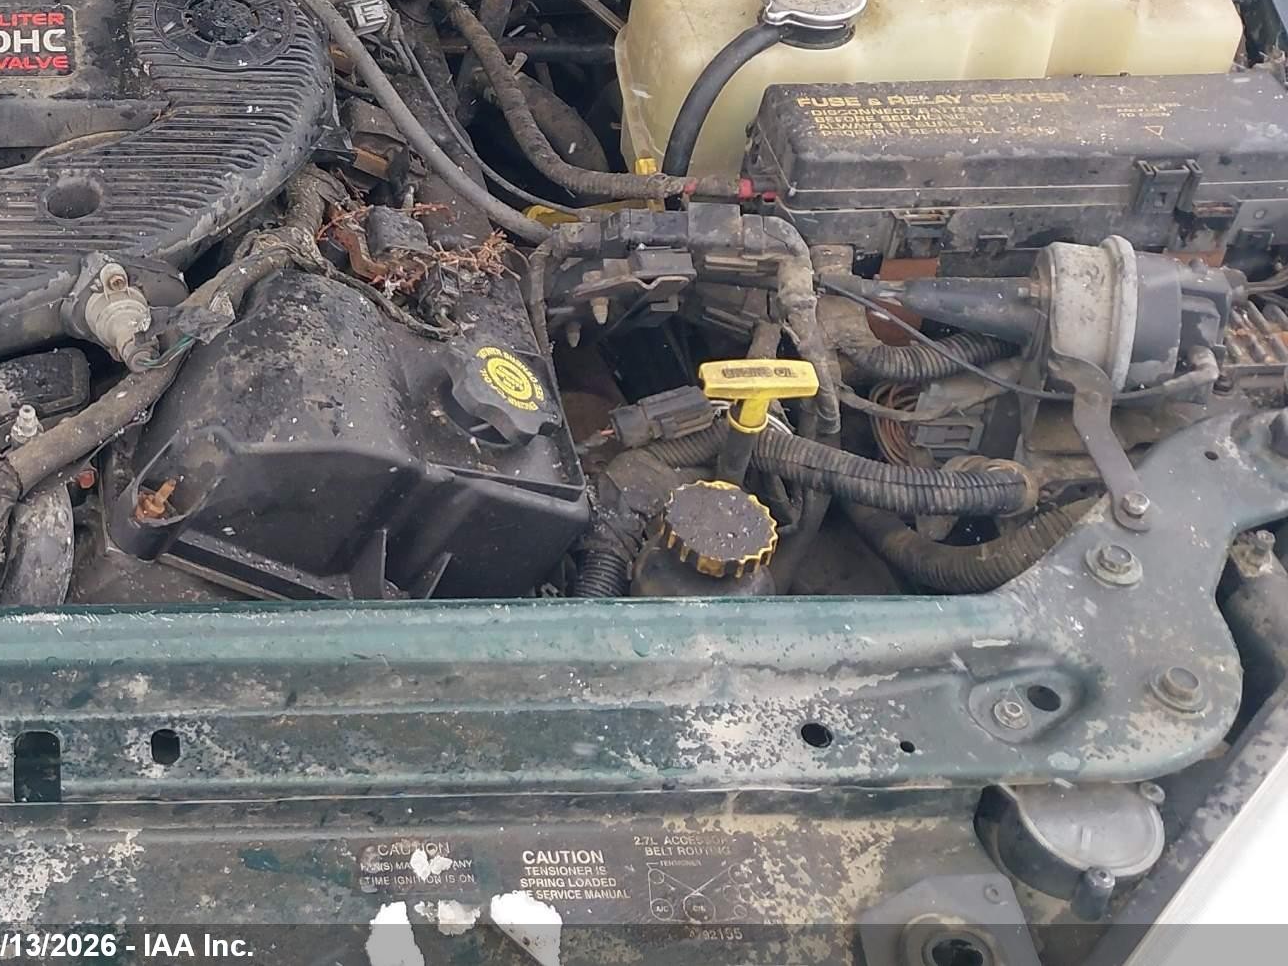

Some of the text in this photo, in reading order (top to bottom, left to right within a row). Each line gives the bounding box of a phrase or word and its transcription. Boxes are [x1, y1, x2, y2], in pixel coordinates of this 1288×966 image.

[797, 92, 1070, 107] FUSE & RELAY CENTER
[634, 835, 658, 845] 2.7L
[645, 846, 673, 856] BELT
[522, 850, 605, 864] CAUTION
[453, 860, 473, 870] ANY
[524, 866, 608, 876] TENSIONER IS
[394, 875, 441, 885] IGNITON
[445, 875, 455, 883] IS
[459, 874, 474, 883] ON
[520, 877, 617, 888] SPRING LOADED
[536, 889, 583, 901] SERVICE
[584, 889, 631, 899] MANUAL
